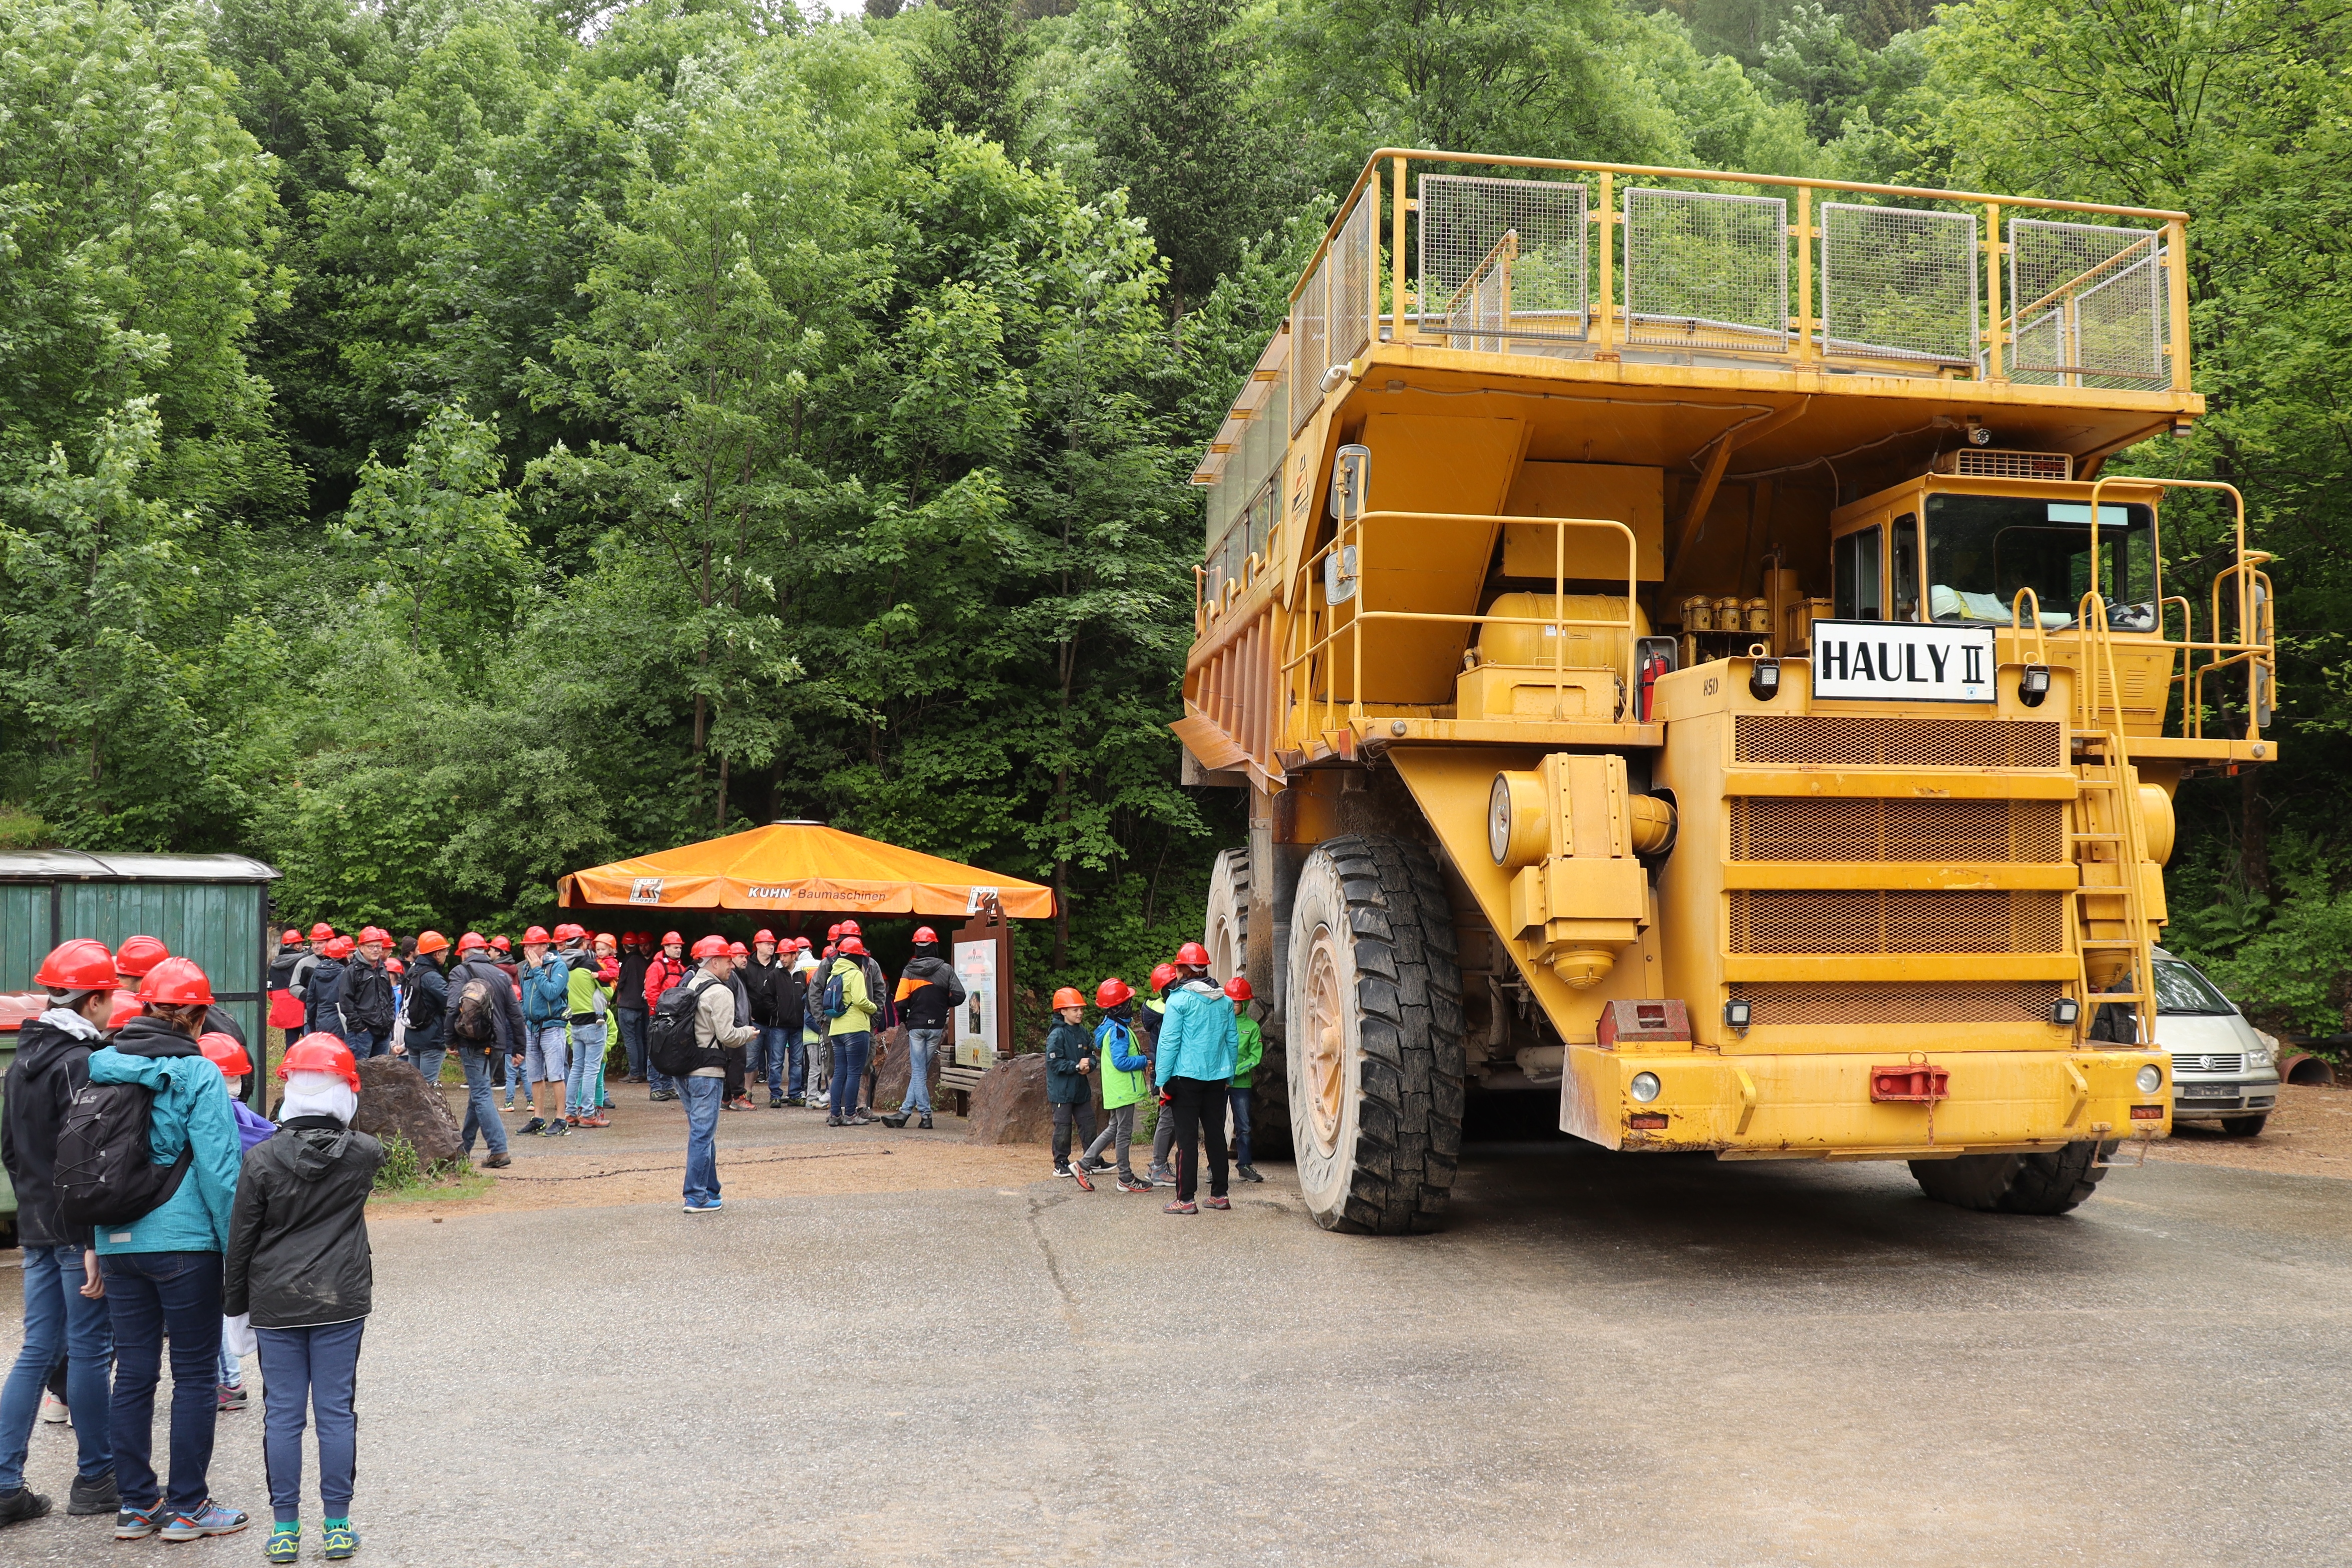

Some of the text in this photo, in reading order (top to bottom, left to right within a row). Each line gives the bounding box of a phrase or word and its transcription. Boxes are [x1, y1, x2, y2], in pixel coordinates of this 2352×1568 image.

[2034, 462, 2063, 471] BEHR
[1822, 640, 1985, 684] HAULY II
[748, 887, 791, 899] KUHN
